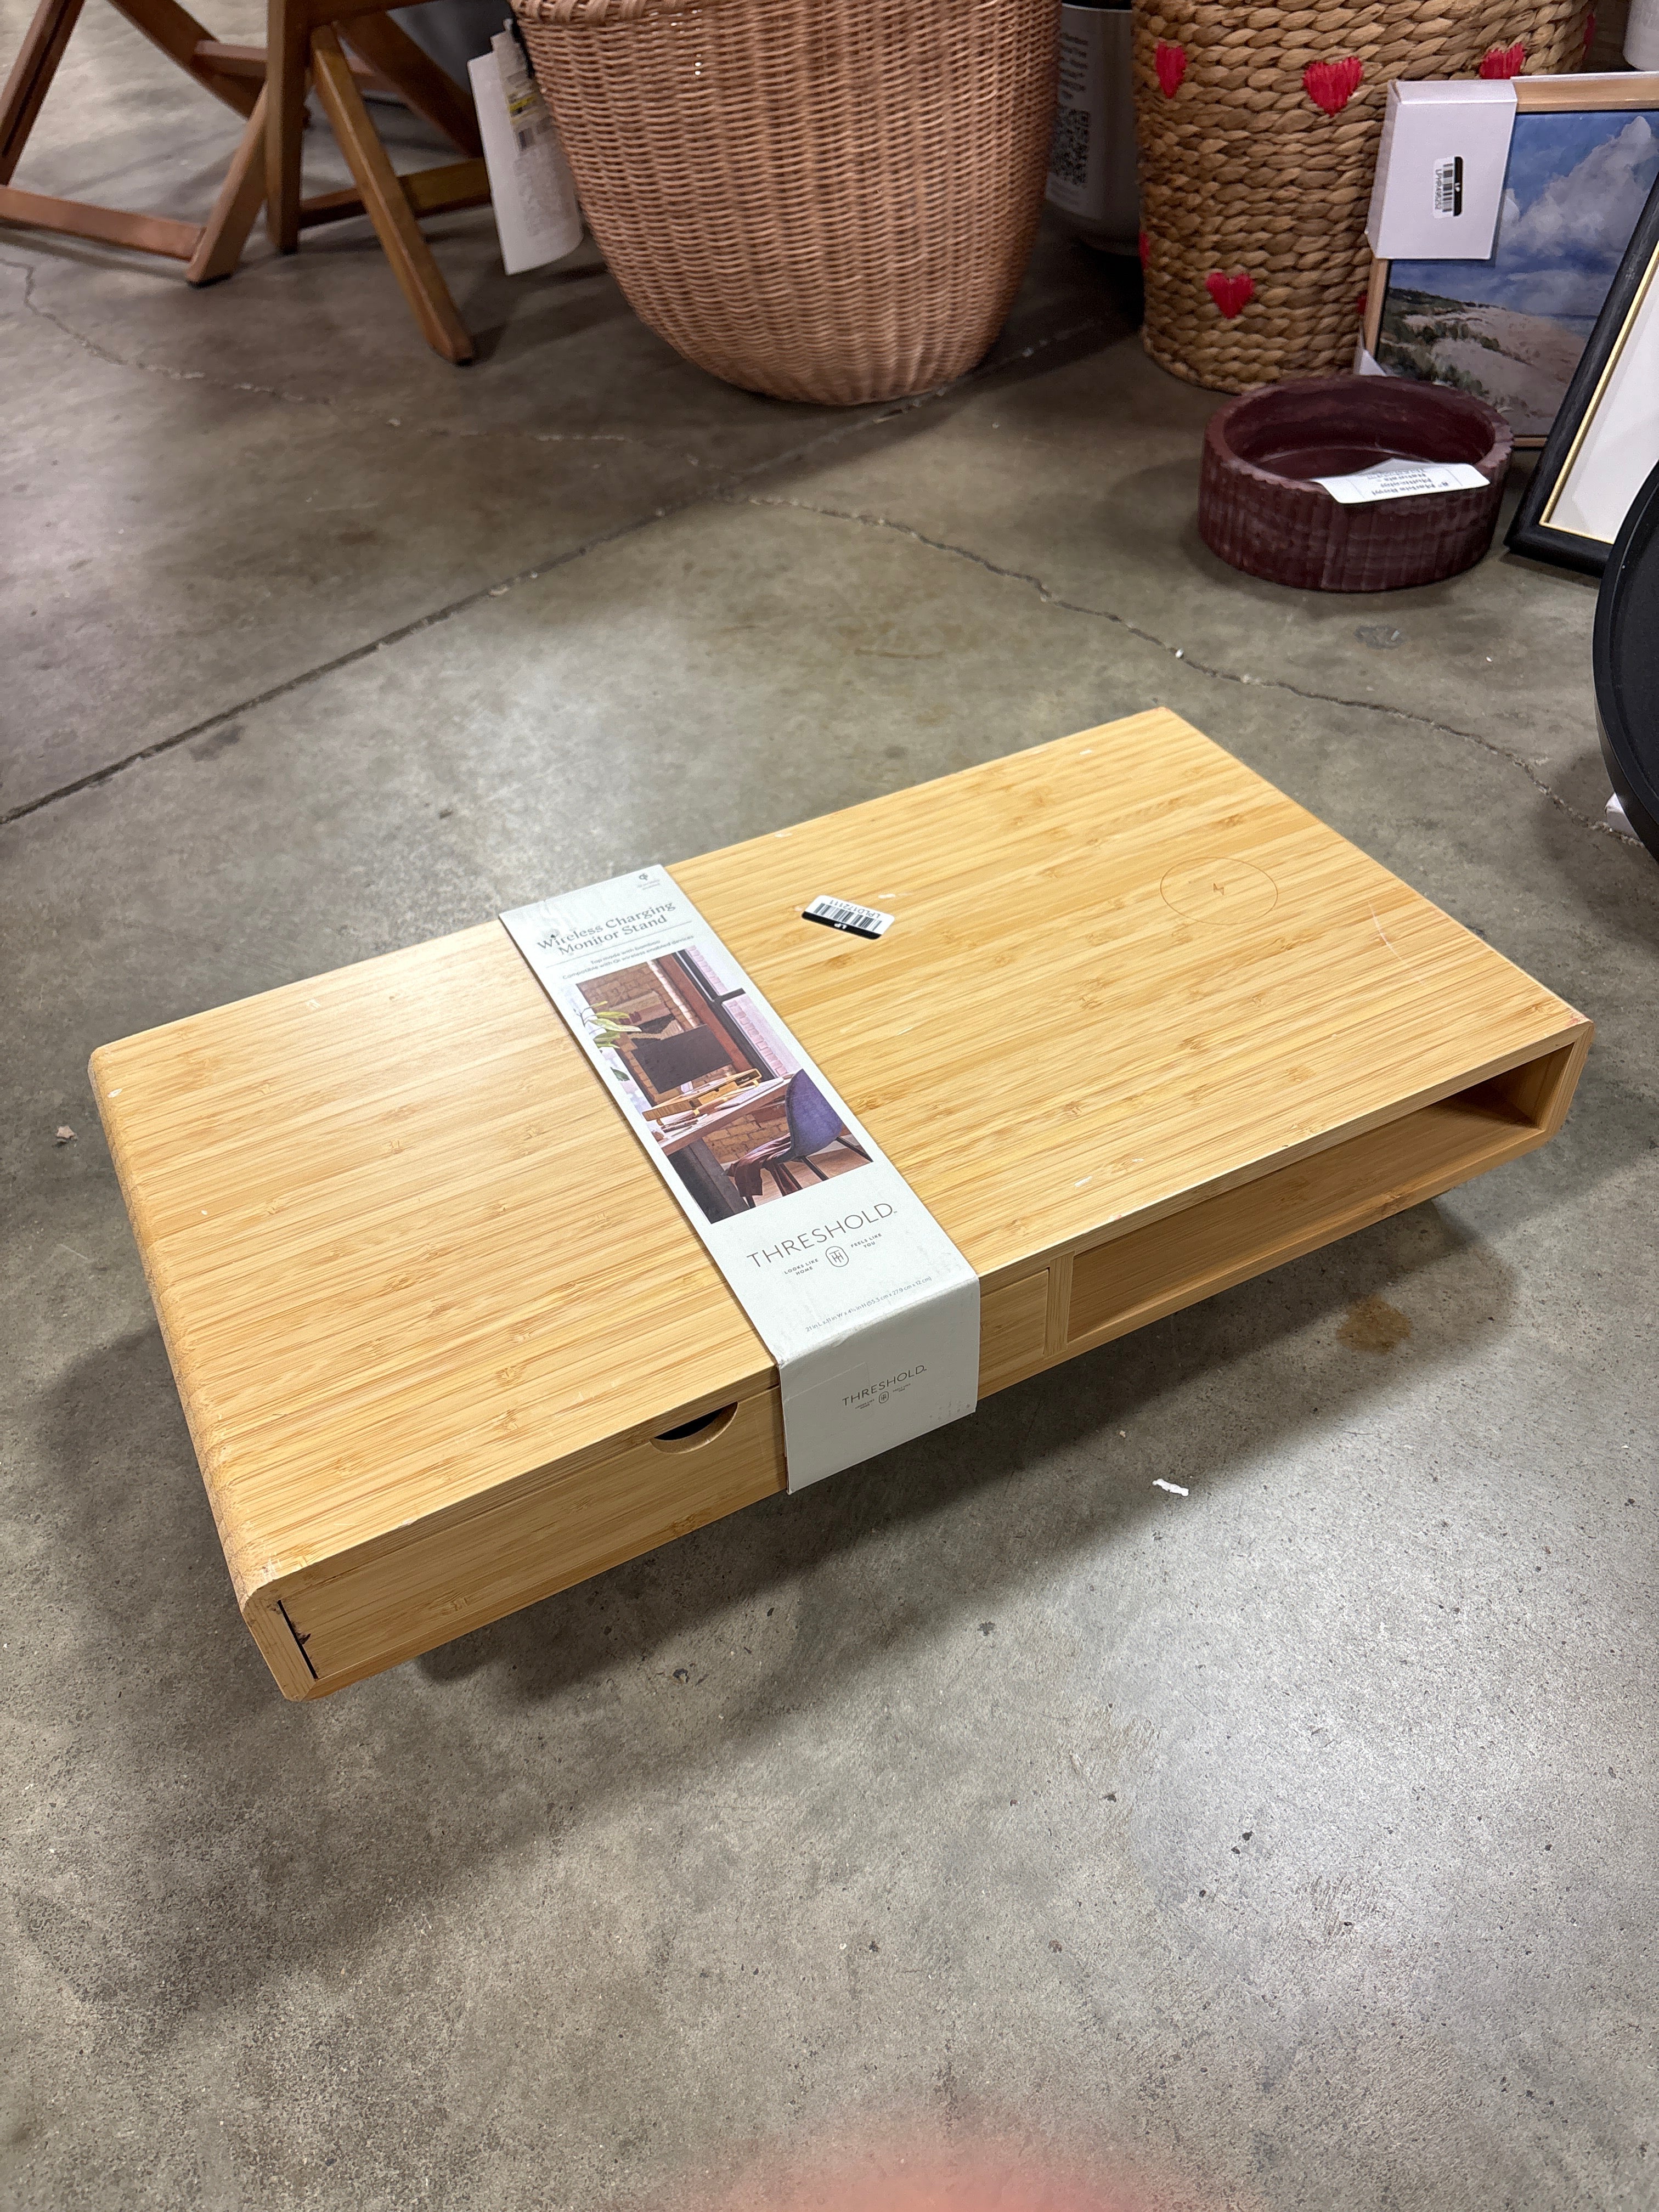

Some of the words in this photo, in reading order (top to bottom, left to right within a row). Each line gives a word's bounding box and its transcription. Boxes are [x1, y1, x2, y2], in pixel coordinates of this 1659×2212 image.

[830, 900, 881, 918] LPLD172111
[537, 924, 603, 950] Wireless
[606, 902, 676, 929] Charging
[558, 932, 619, 955] Monitor
[622, 915, 668, 935] Stand
[635, 940, 661, 951] bamboo
[563, 965, 599, 980] Compatible
[622, 951, 645, 961] wireless
[646, 942, 671, 953] enabled
[672, 935, 694, 945] devices
[850, 1239, 868, 1248] FEELS
[784, 1264, 805, 1275] LOOKS
[805, 1258, 819, 1267] LIKE
[795, 1266, 813, 1276] HOME
